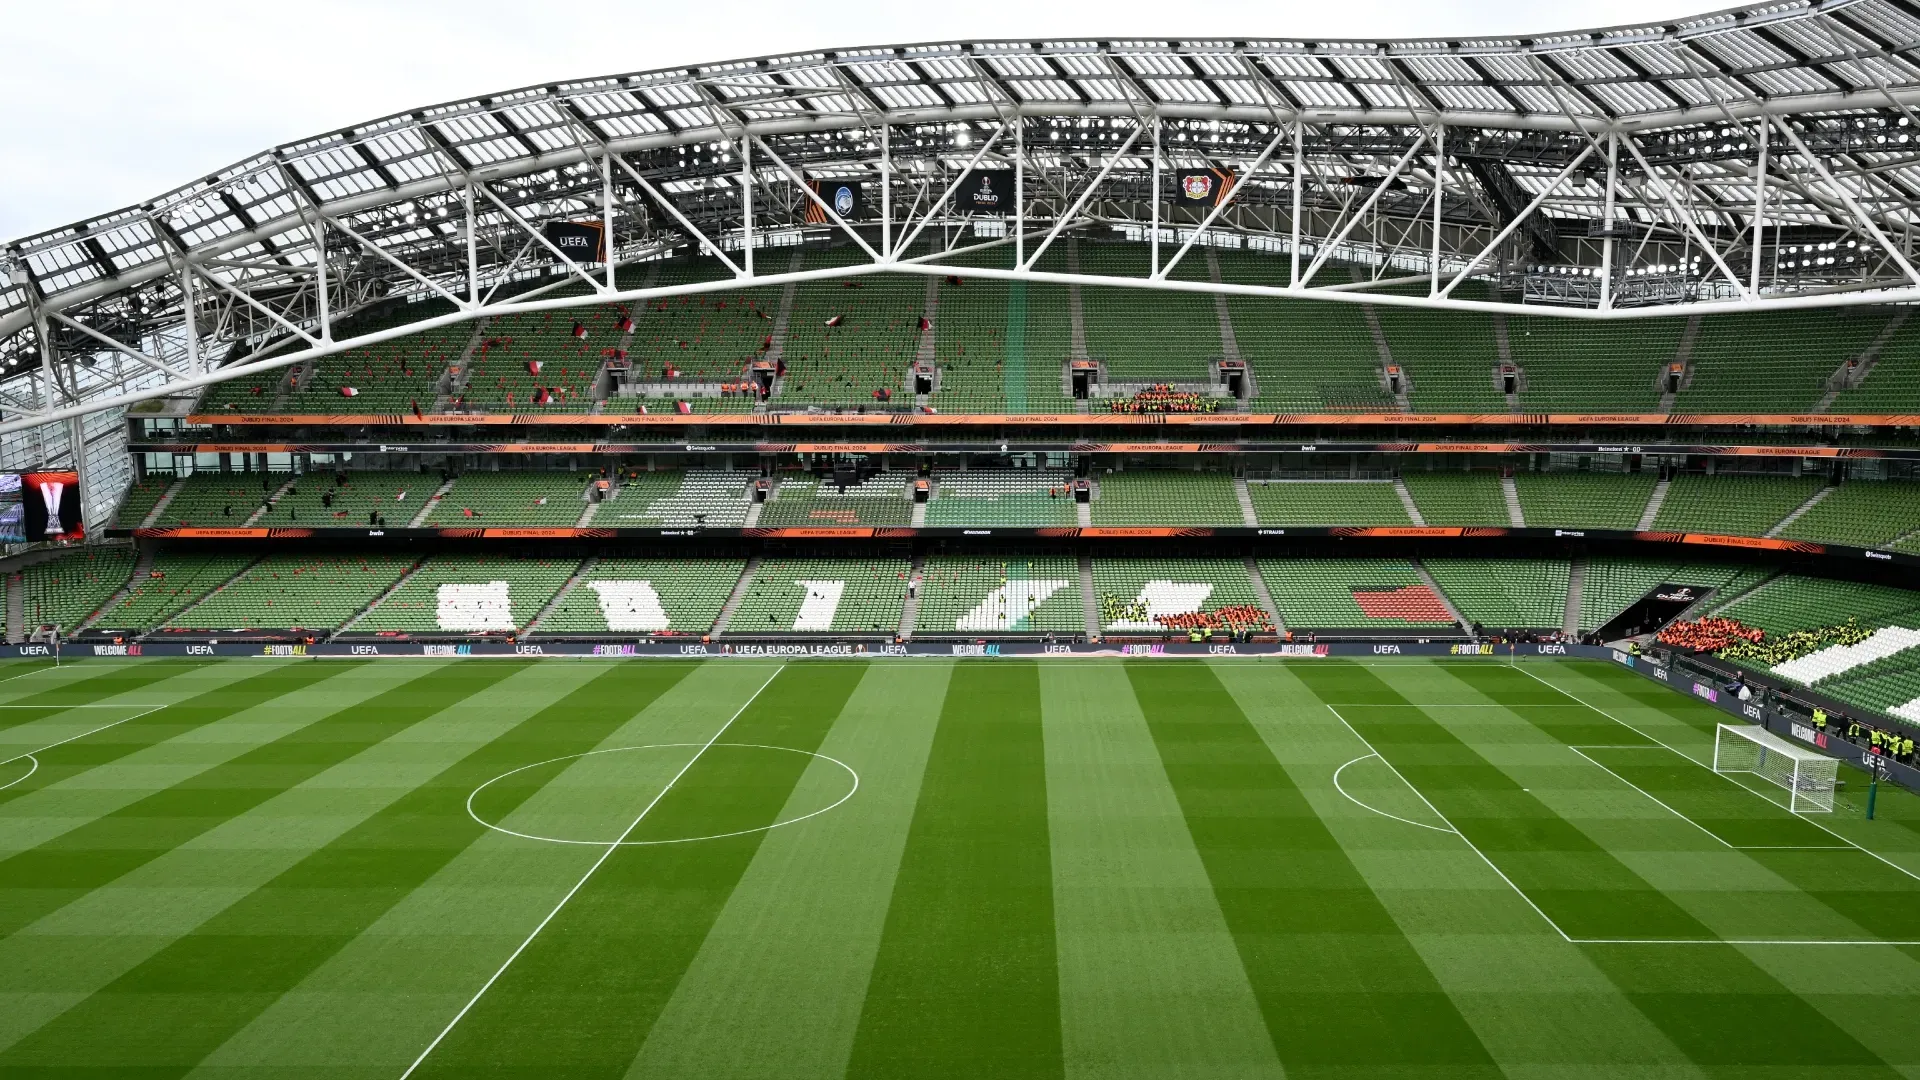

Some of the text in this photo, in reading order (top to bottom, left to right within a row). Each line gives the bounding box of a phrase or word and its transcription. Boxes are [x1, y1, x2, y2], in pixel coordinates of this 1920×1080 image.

[974, 194, 998, 202] DUBLIN
[560, 237, 588, 246] UEFA
[20, 646, 49, 655] UEFA
[186, 646, 214, 654] UEFA
[351, 646, 378, 654] UEFA
[516, 646, 543, 654] UEFA
[680, 646, 707, 654] UEFA
[736, 646, 852, 654] UEFA EUROPA LEAGUE
[880, 646, 907, 654] UEFA
[1209, 646, 1236, 654] UEFA
[1374, 645, 1400, 654] UEFA
[1538, 645, 1566, 654] UEFA
[1654, 667, 1668, 681] UEFA
[1744, 704, 1760, 720] UEFA
